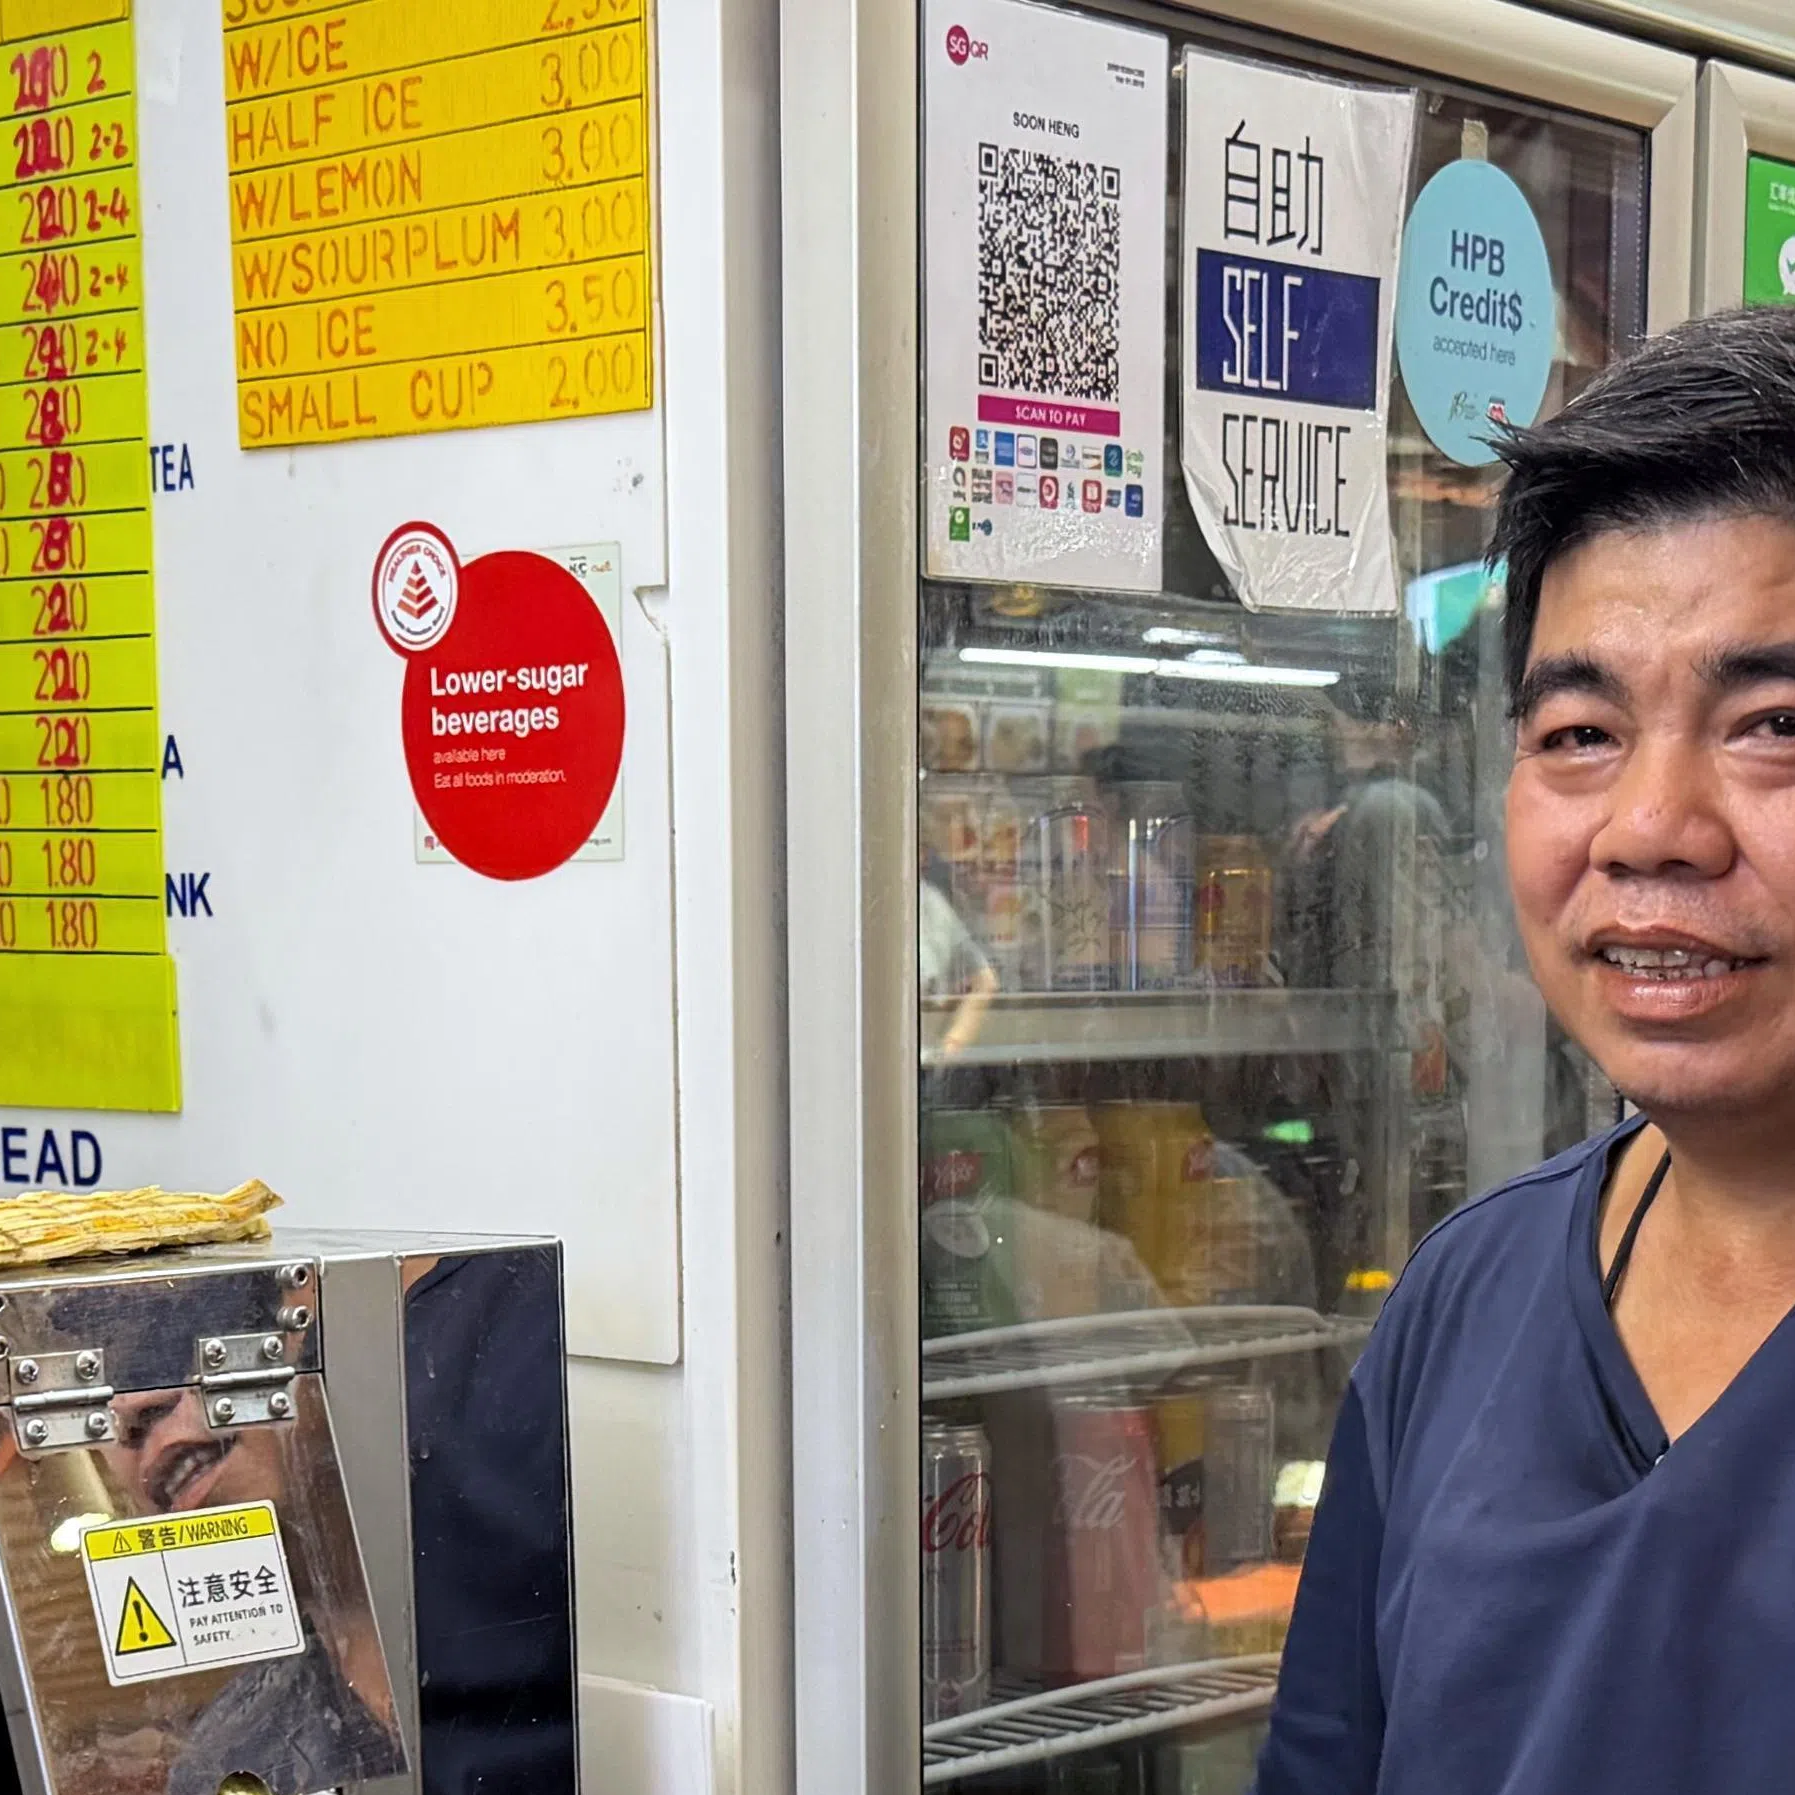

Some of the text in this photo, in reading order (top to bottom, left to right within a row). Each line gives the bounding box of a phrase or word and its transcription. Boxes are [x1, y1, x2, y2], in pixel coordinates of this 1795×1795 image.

[229, 18, 348, 92] W/ICE
[232, 93, 334, 163] HALF
[362, 76, 423, 136] ICE
[1013, 111, 1080, 139] SOON HENG
[235, 149, 423, 232] W/LEMON
[1225, 119, 1324, 256] 自助
[1451, 229, 1505, 278] HPB
[241, 267, 636, 369] NO ICE 3.50
[1222, 266, 1304, 392] SELF
[1429, 276, 1523, 335] Credit$
[1432, 334, 1487, 362] accepted
[243, 343, 635, 439] SMALL CUP 2.00
[1015, 404, 1086, 427] SCAN TO PAY
[1222, 412, 1351, 538] SERVICE
[431, 660, 588, 697] Lower-sugar
[432, 703, 559, 738] beverages
[161, 734, 184, 780] A
[177, 1564, 279, 1608] 注意安全
[211, 1606, 266, 1626] ATTENTION
